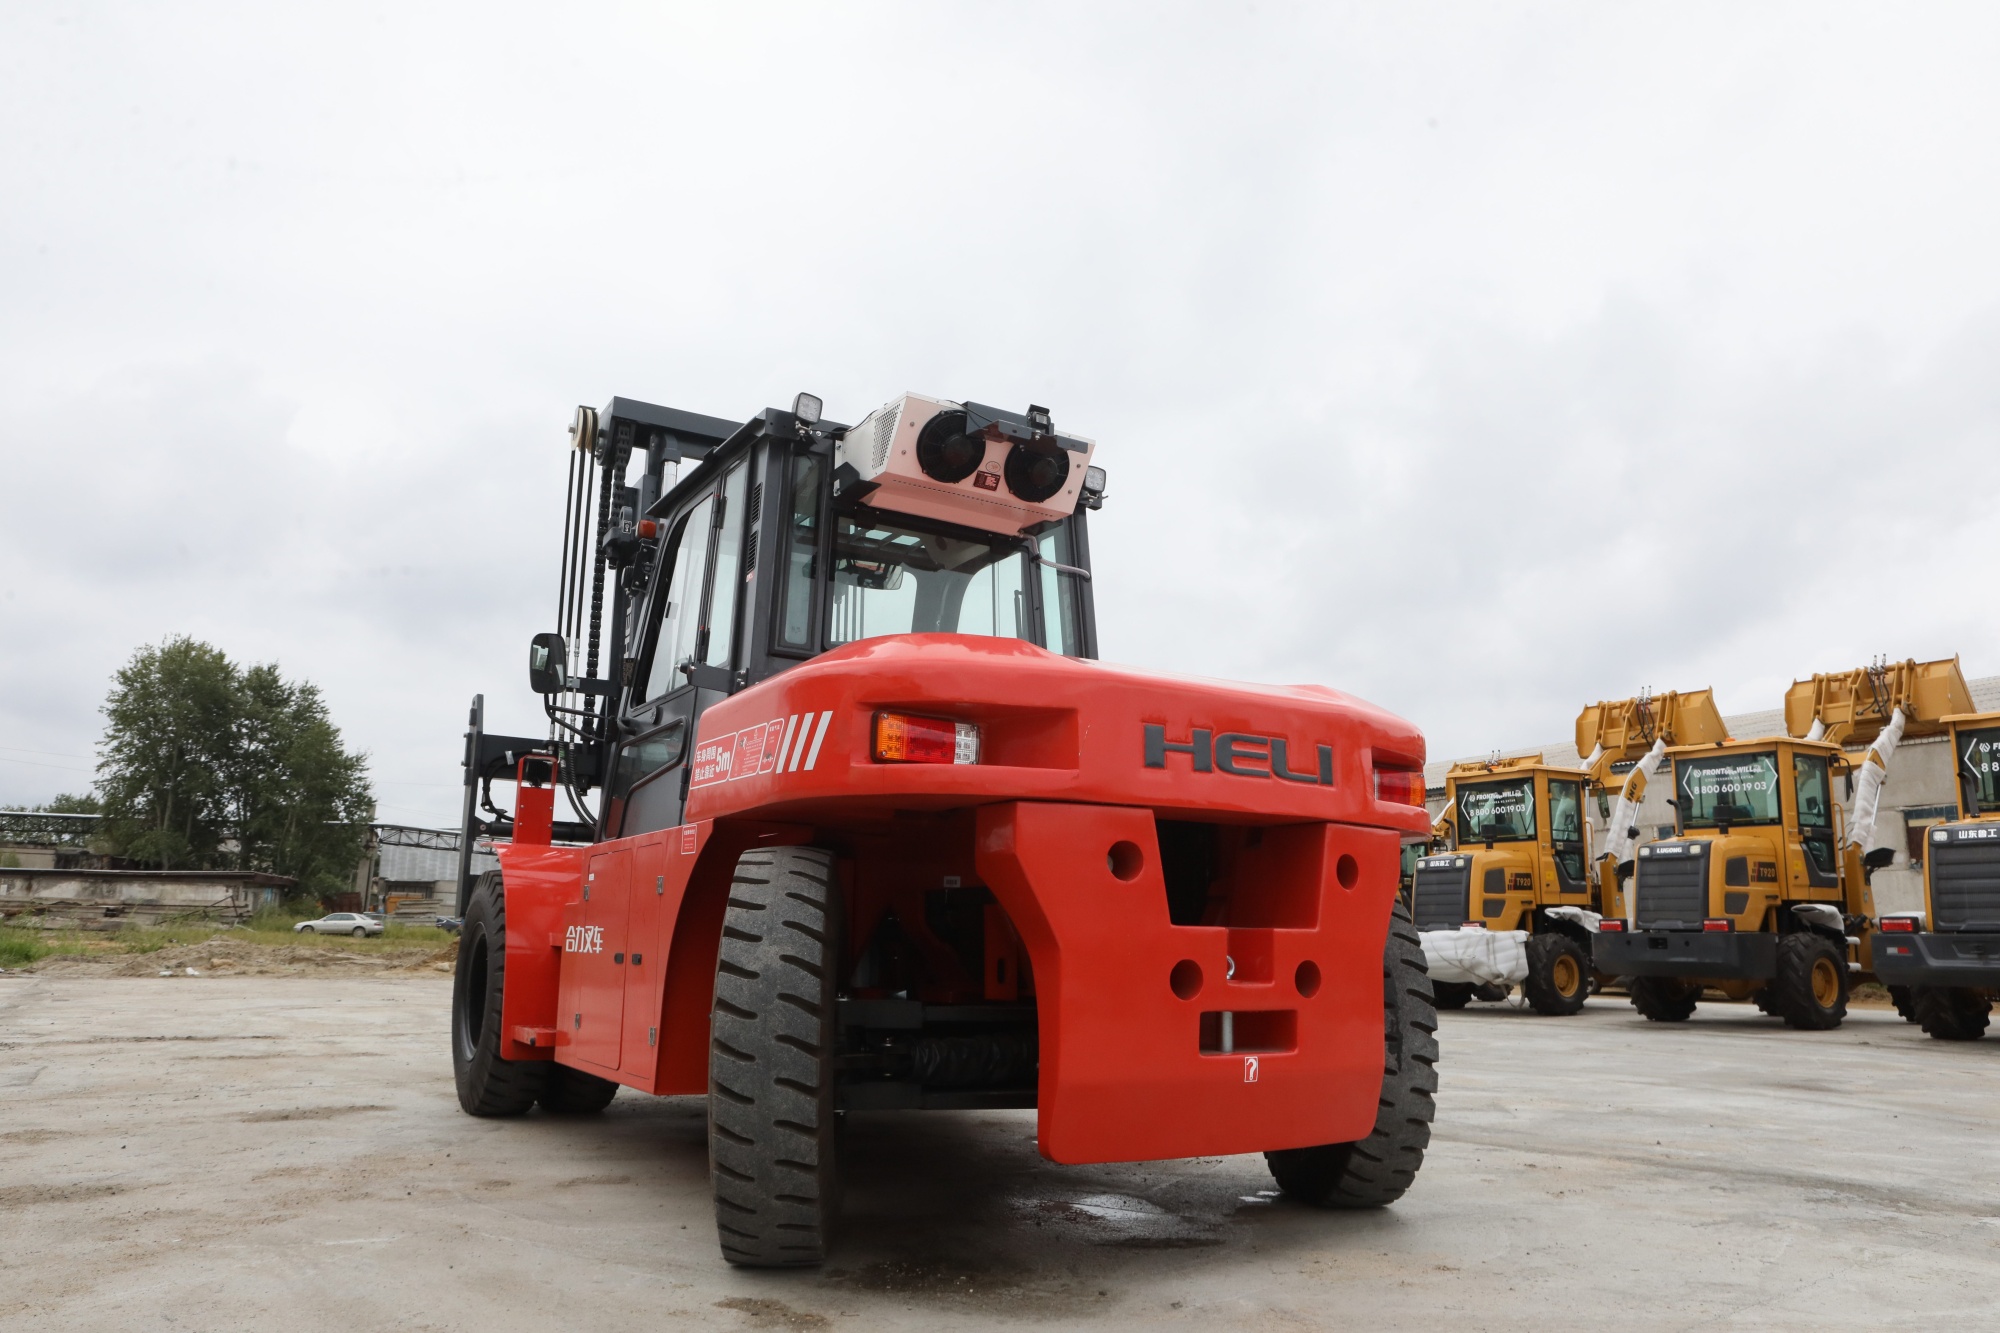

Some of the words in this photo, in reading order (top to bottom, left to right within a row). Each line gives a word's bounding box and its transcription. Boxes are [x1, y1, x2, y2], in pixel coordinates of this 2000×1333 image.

[716, 746, 730, 773] 5m
[1144, 723, 1334, 786] HELI
[1981, 762, 1989, 772] 8
[1694, 786, 1700, 795] 8
[1701, 785, 1720, 794] 800
[1721, 783, 1740, 793] 600
[1742, 782, 1752, 791] 19
[1754, 781, 1767, 790] 03
[1470, 809, 1474, 817] 8
[1475, 808, 1490, 816] 800
[1491, 806, 1506, 814] 600
[1515, 804, 1526, 812] 03
[1656, 846, 1683, 854] LUGONG
